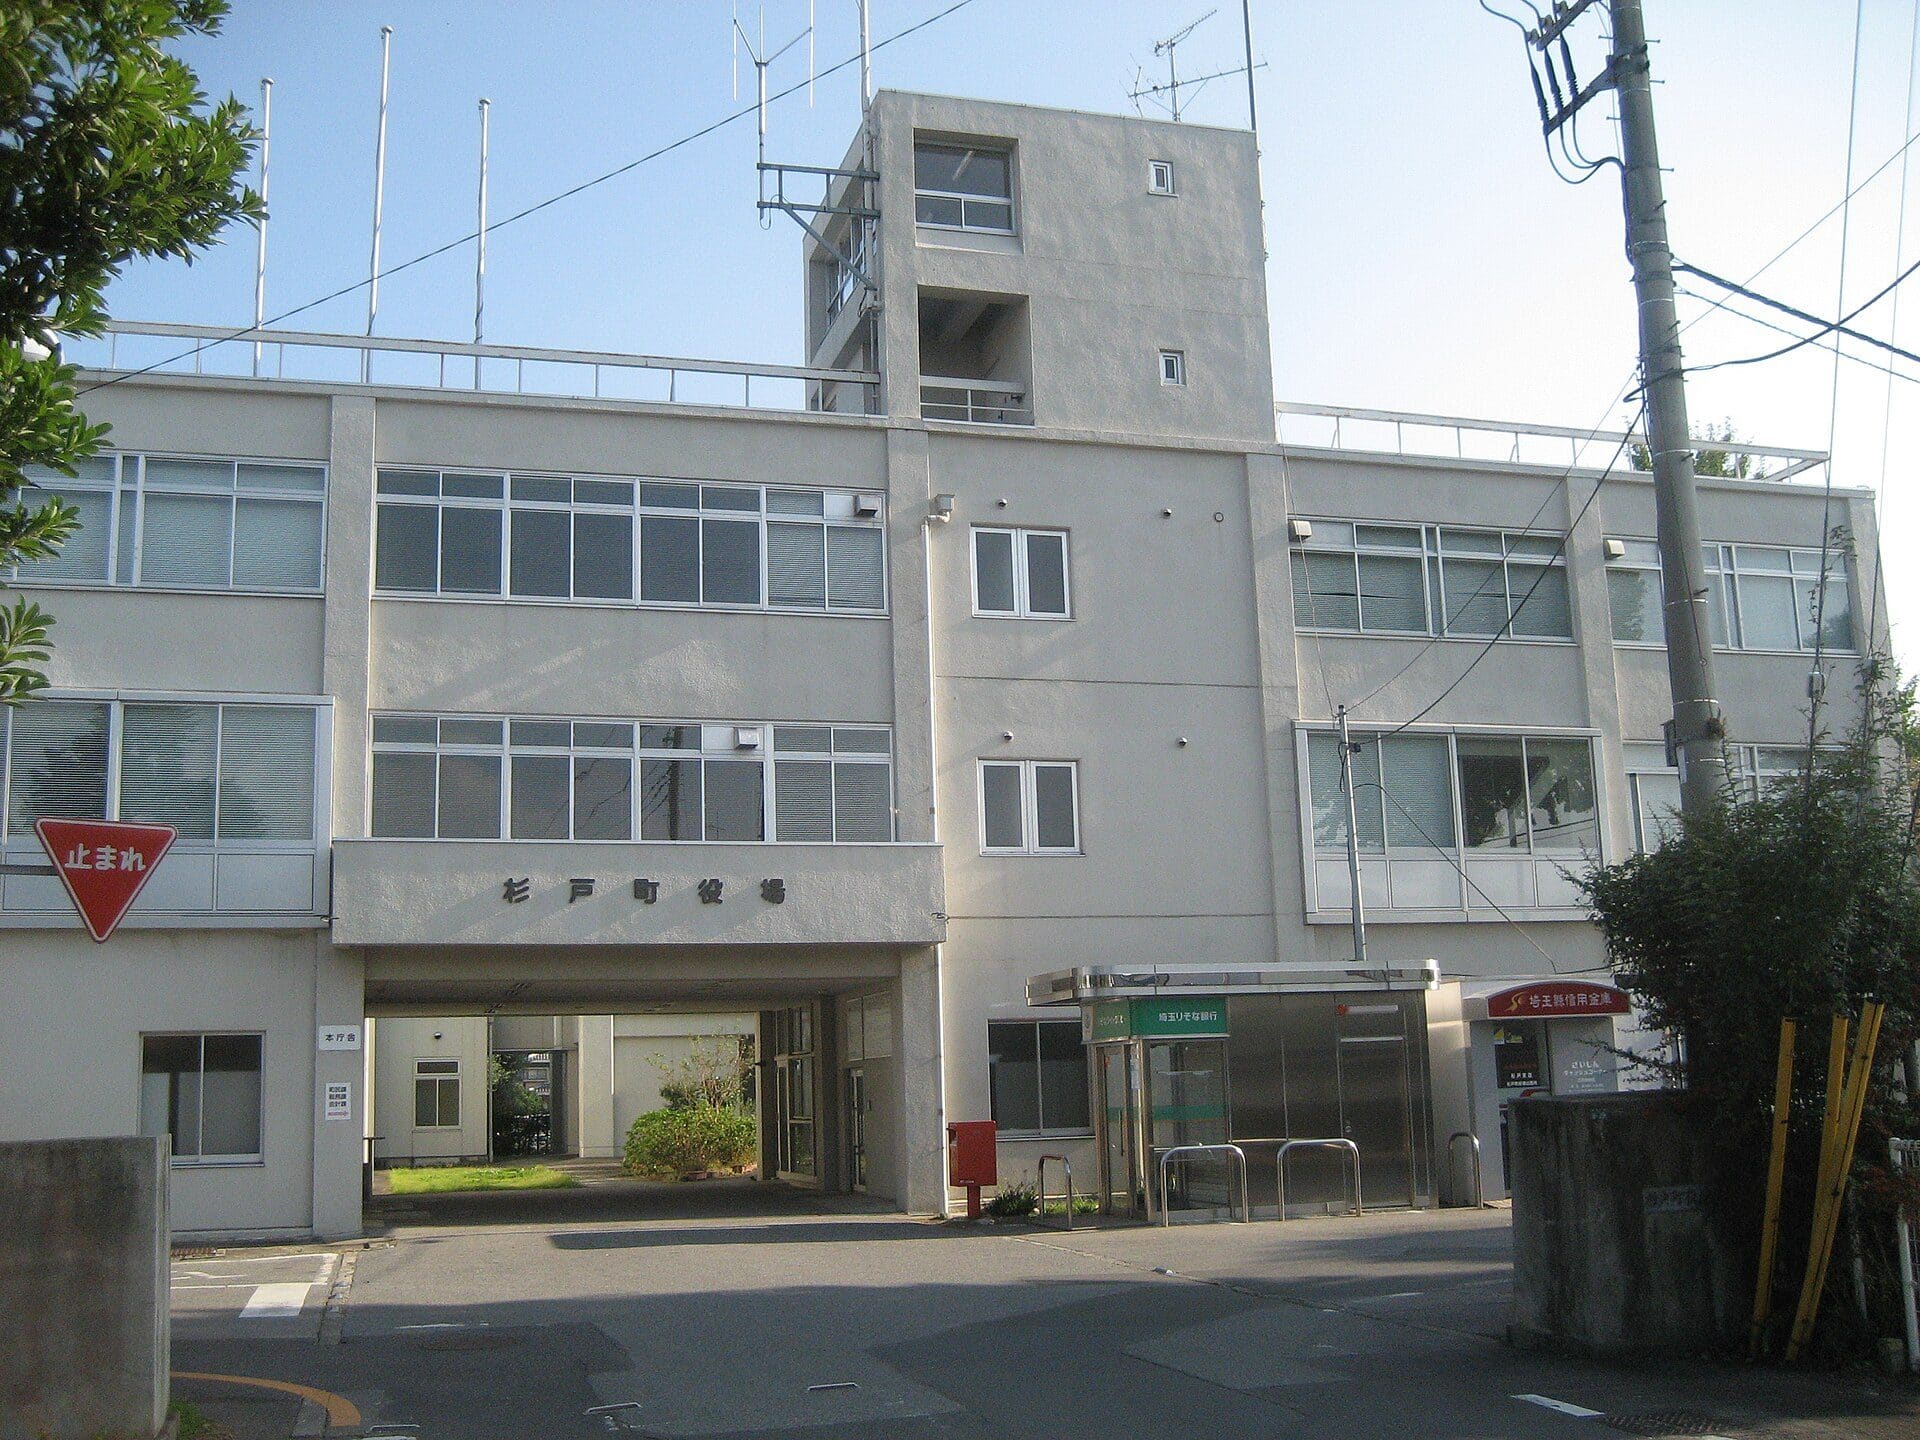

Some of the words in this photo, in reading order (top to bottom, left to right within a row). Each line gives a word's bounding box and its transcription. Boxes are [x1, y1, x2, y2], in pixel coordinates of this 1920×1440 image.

[64, 843, 146, 872] 止まれ
[503, 877, 786, 904] 杉戸町役場
[1158, 1011, 1218, 1022] 埼玉りそな銀行
[325, 1032, 356, 1042] 本庁舎
